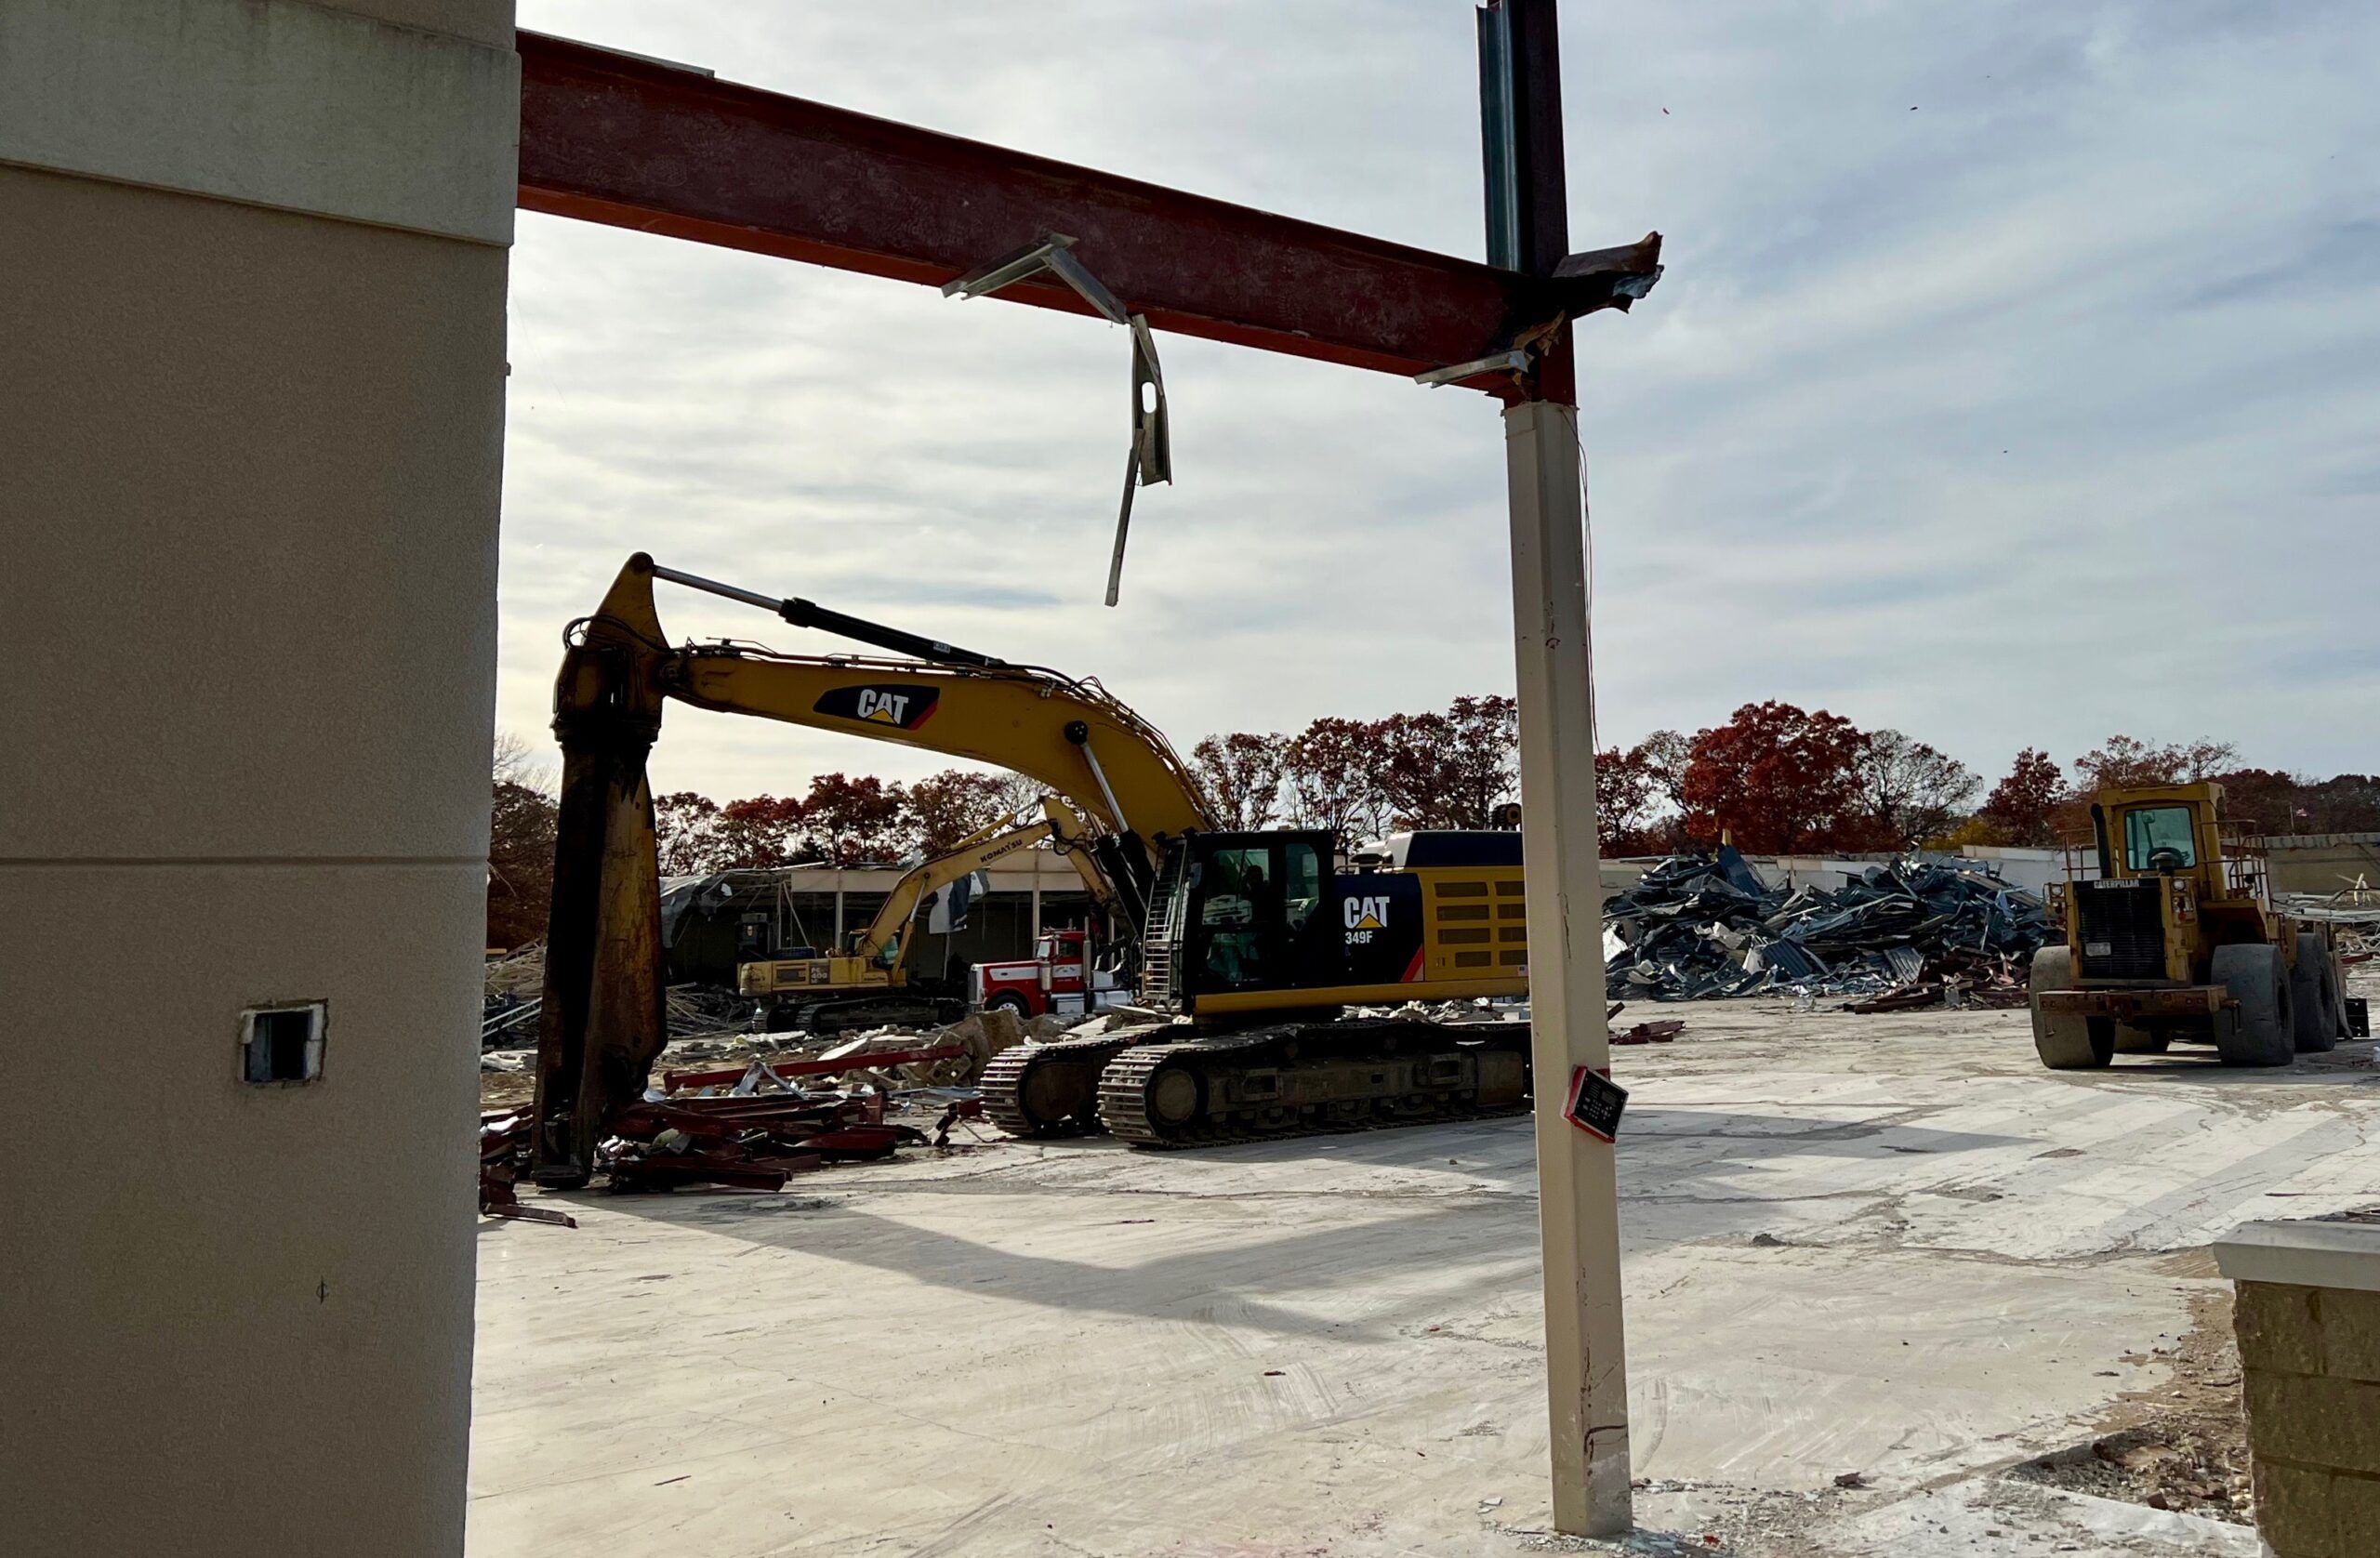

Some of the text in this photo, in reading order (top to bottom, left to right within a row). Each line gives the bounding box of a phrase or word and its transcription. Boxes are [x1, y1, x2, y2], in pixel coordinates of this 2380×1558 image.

[857, 689, 909, 724] CAT
[980, 839, 1023, 863] KOMATSU
[2094, 879, 2139, 889] CATERPILLAR
[1344, 896, 1390, 929] CAT
[1345, 931, 1373, 944] 349F
